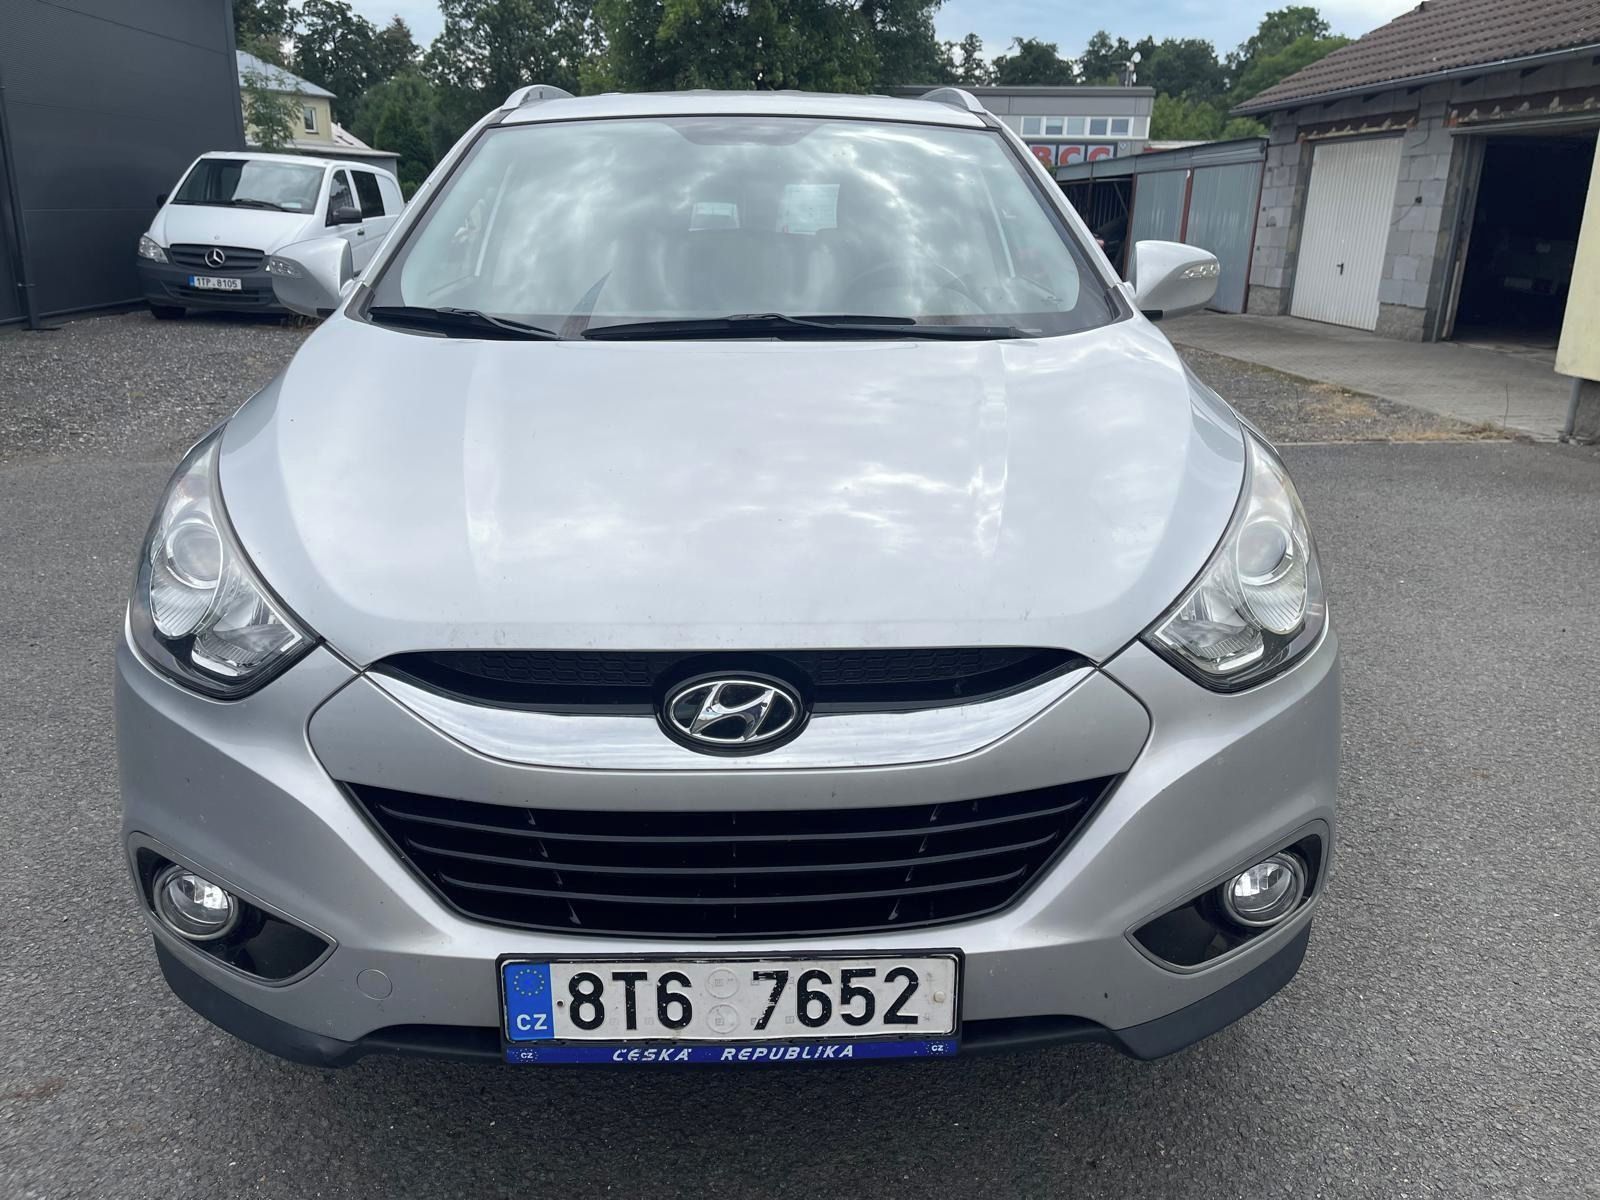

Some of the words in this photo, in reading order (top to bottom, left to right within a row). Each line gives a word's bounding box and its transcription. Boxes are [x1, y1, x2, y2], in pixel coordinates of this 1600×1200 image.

[197, 277, 211, 286] 1TP
[217, 279, 238, 288] 8105
[569, 971, 693, 1031] 8T6
[752, 966, 919, 1030] 7652
[516, 1013, 548, 1031] CZ
[720, 1045, 854, 1061] REPUBLIKA
[931, 1044, 944, 1052] CZ
[520, 1052, 534, 1060] CZ
